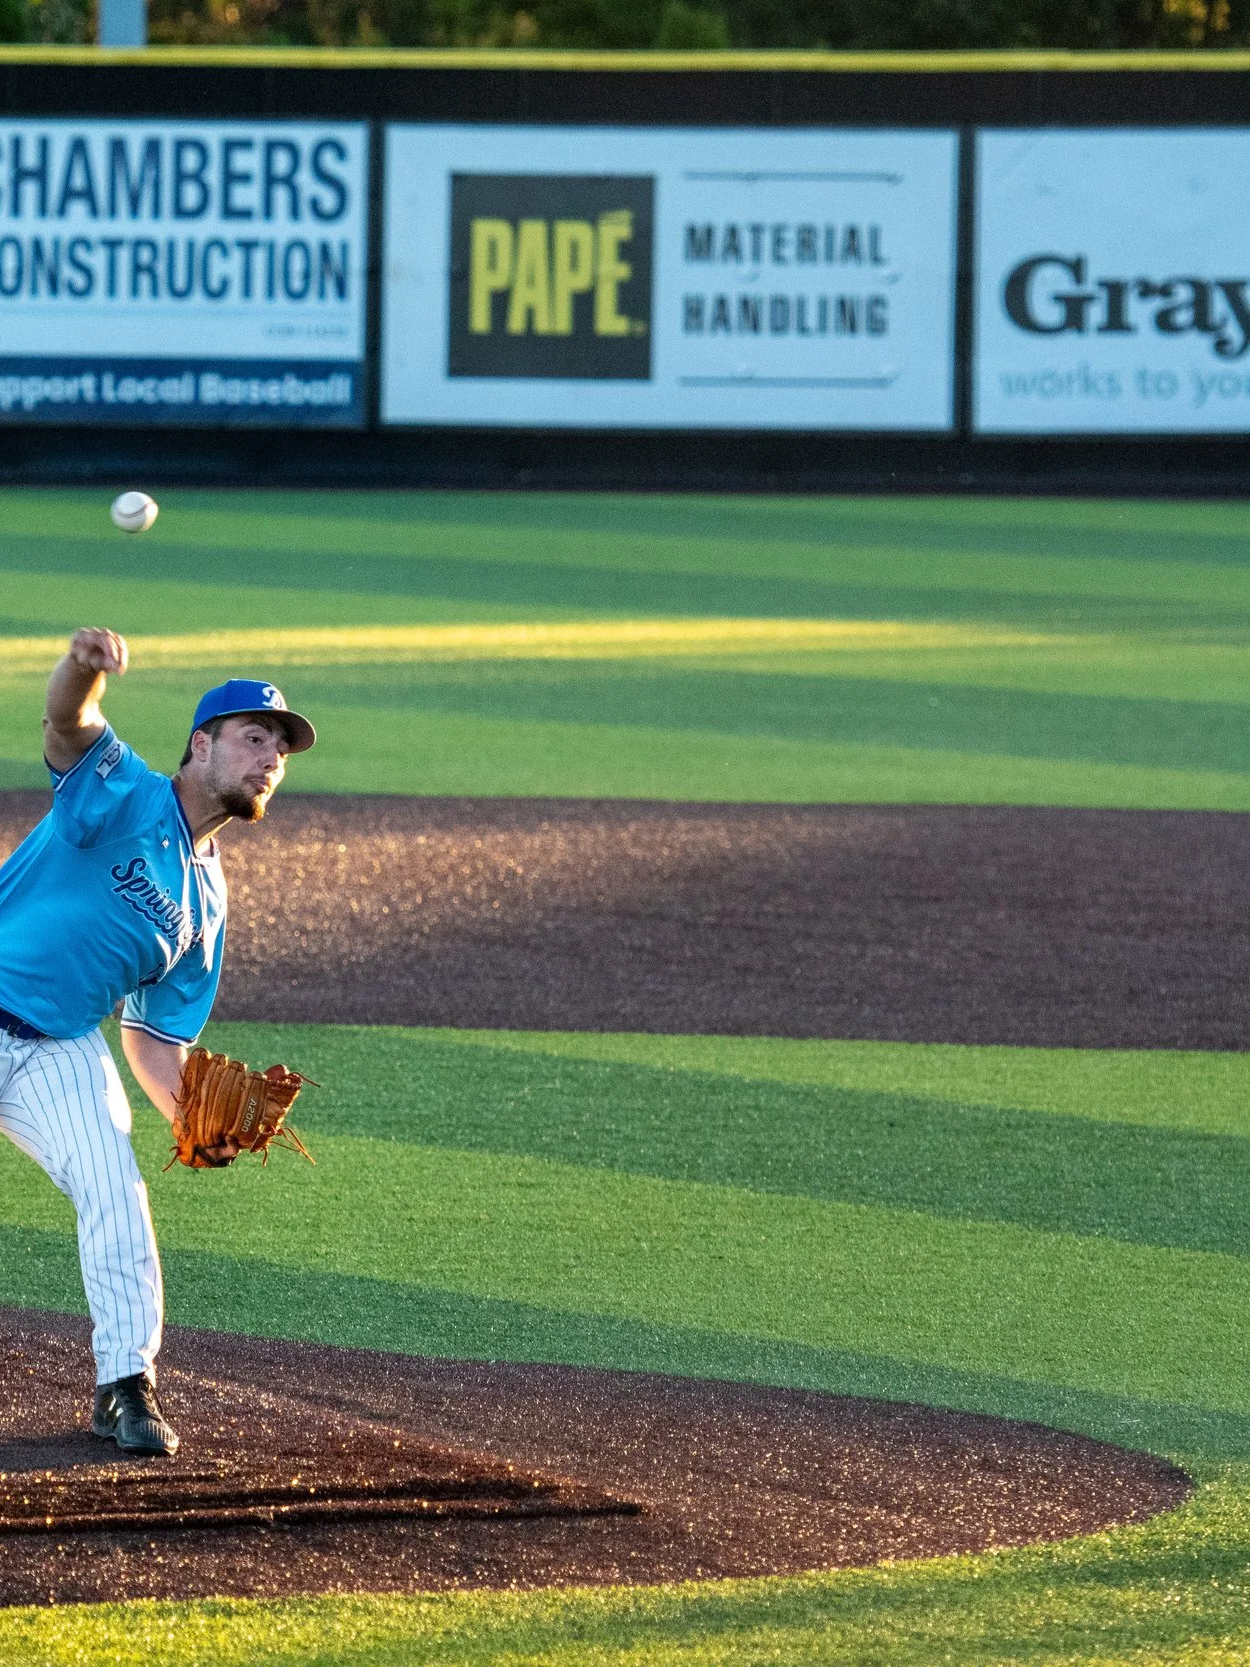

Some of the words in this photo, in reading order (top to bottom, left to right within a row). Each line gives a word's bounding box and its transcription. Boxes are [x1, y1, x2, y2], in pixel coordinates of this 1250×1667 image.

[683, 221, 889, 267] MATERIAL
[468, 208, 634, 337] PAPÉ
[681, 293, 891, 338] HANDLING
[1003, 252, 1250, 361] Gray
[101, 371, 196, 405] Local
[200, 371, 351, 406] Baseball
[1000, 360, 1123, 399] works
[1135, 367, 1180, 399] to
[1188, 368, 1250, 408] yo
[241, 1096, 258, 1133] A2000
